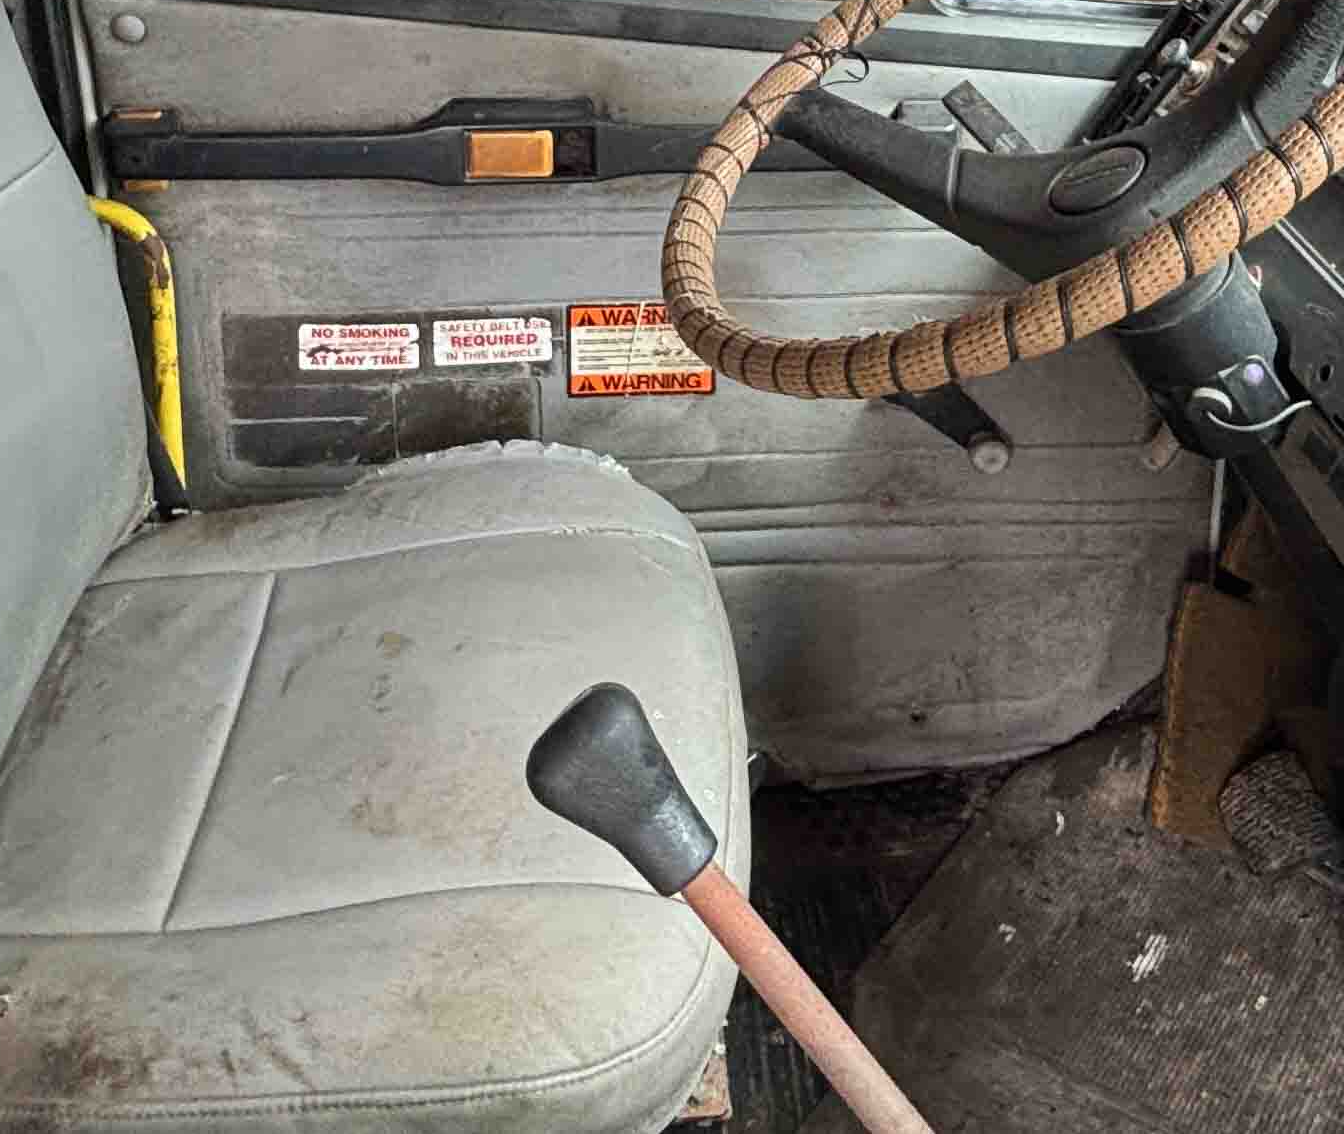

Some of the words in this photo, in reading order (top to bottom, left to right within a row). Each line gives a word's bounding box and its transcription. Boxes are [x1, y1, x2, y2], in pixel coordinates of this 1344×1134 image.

[602, 309, 670, 325] WARN
[311, 328, 334, 338] NO
[339, 328, 410, 338] SMOKING
[439, 322, 486, 333] SAFETY
[490, 321, 521, 331] BELT
[450, 333, 538, 347] REQUIRED
[311, 355, 329, 365] AT
[335, 355, 366, 365] ANY
[447, 352, 457, 361] IN
[463, 350, 489, 360] THIS
[492, 347, 544, 359] VEHICLE
[601, 373, 702, 390] WARNING
